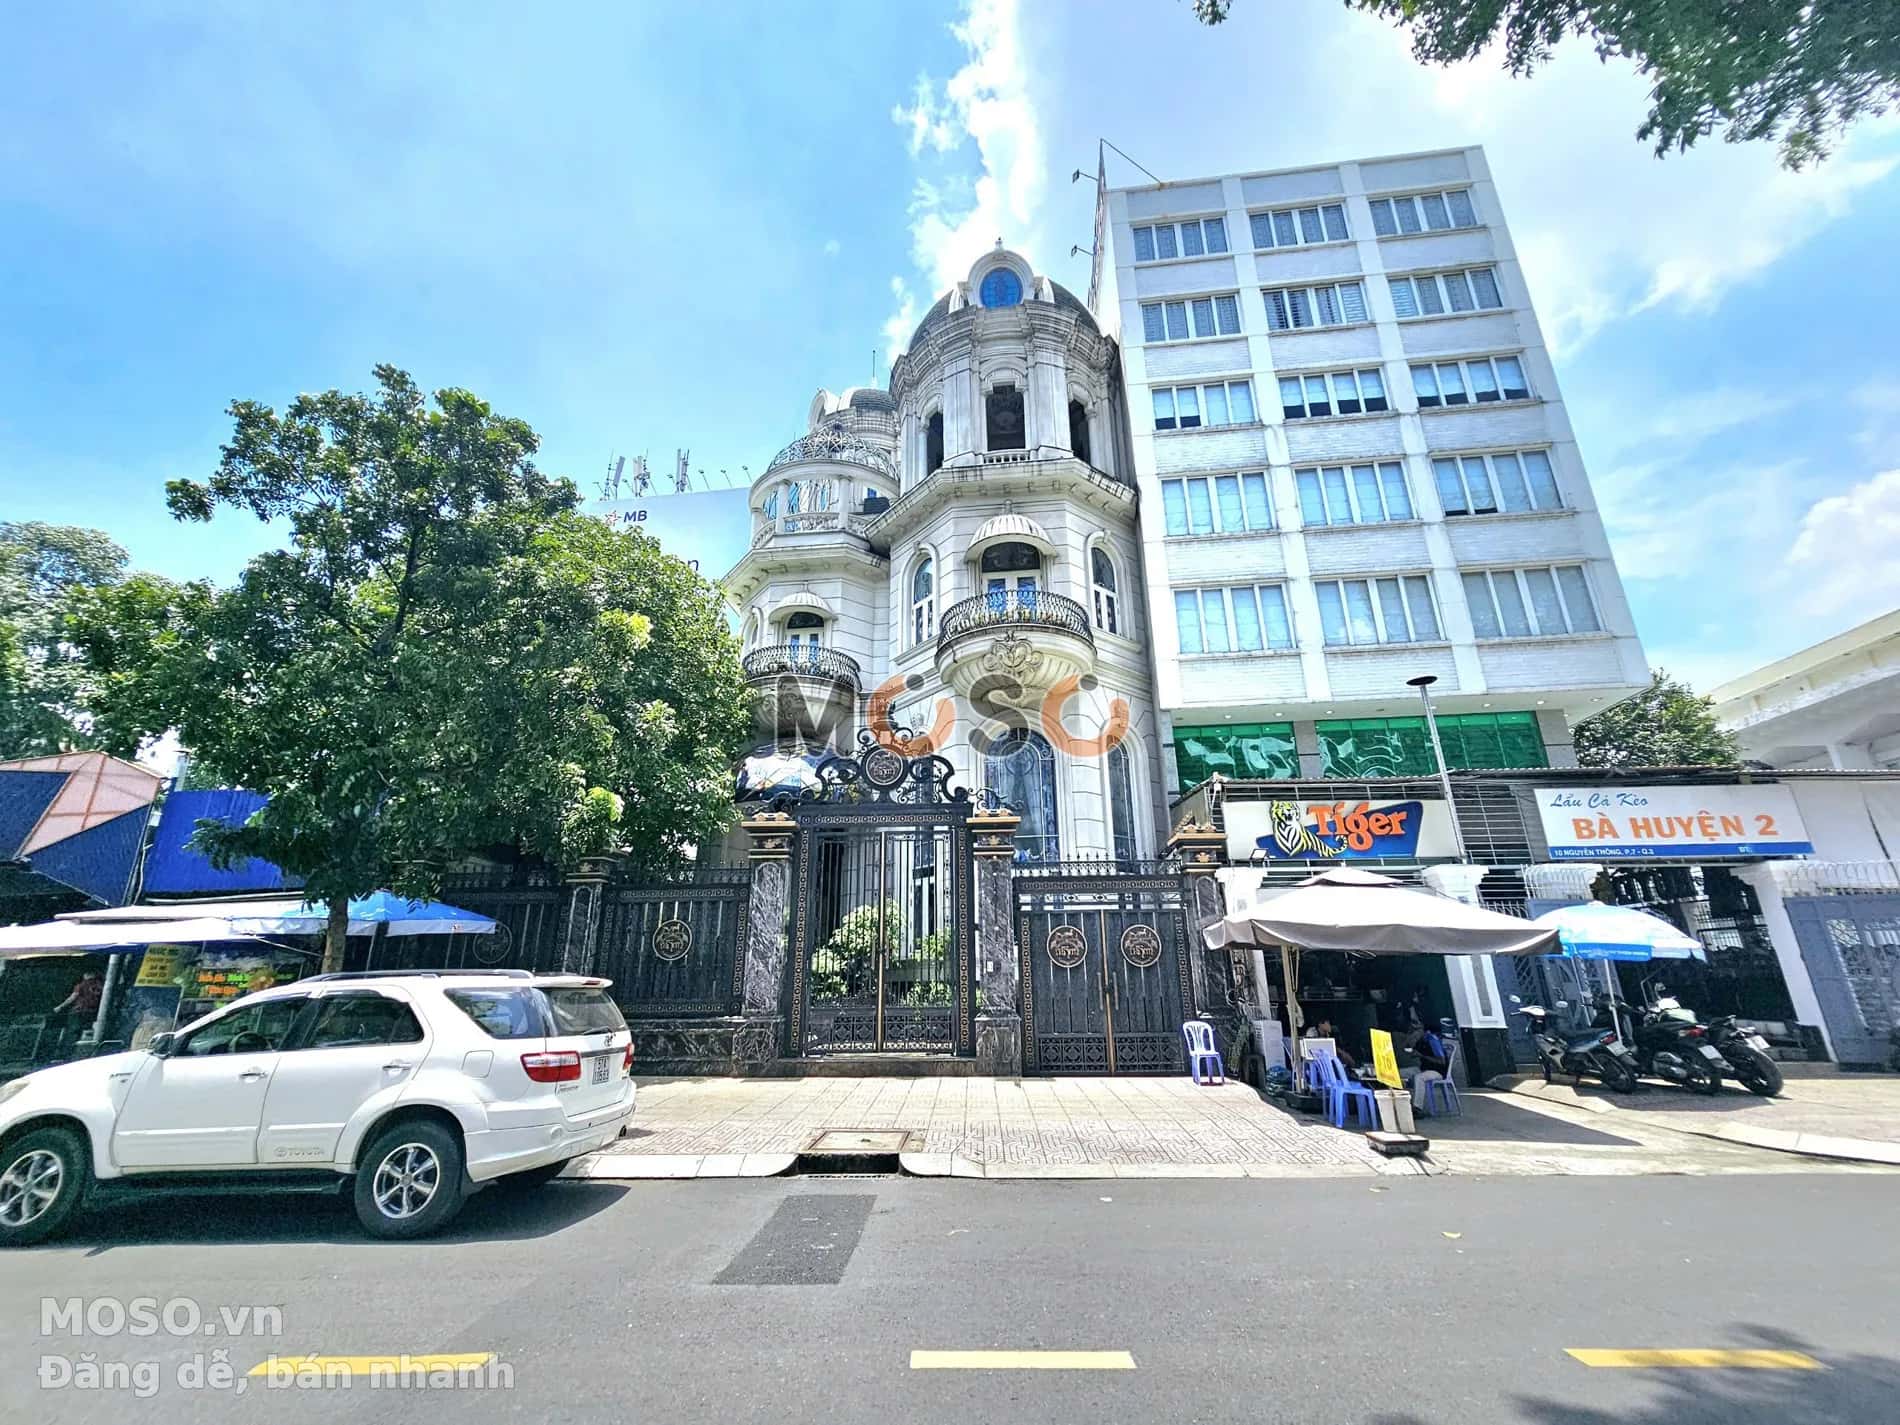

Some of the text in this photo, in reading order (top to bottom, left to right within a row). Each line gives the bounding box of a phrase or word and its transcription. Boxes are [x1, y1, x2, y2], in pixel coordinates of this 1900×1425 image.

[623, 510, 648, 523] MB
[1306, 801, 1408, 851] Tiger
[1572, 810, 1780, 842] BÀ HUYỆN 2
